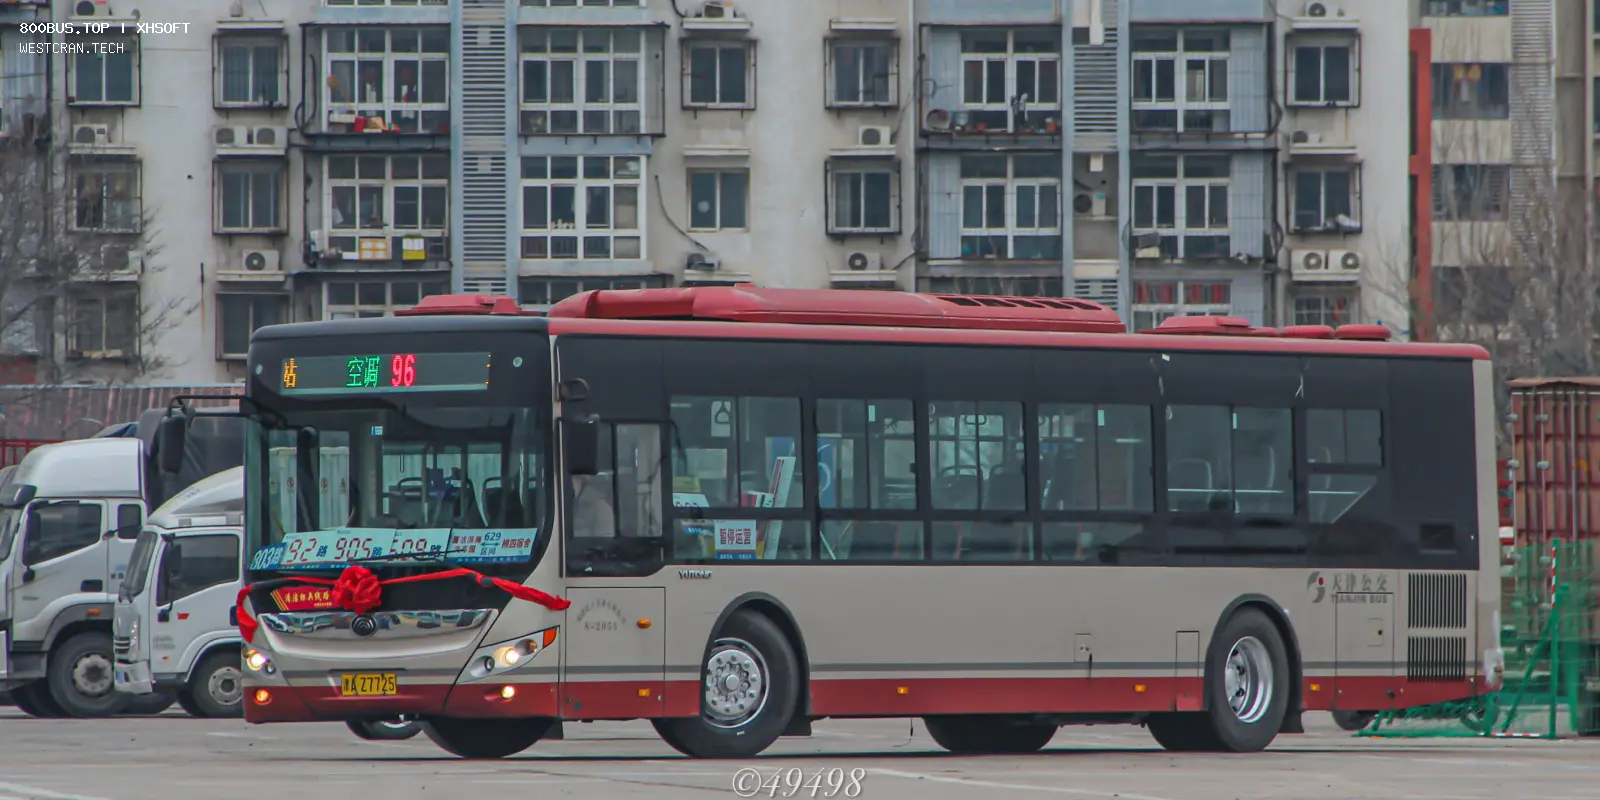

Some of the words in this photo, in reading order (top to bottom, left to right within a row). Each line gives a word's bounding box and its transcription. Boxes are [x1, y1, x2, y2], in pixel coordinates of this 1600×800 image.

[346, 356, 380, 388] 空调
[391, 353, 416, 388] 96
[484, 532, 502, 541] 629
[719, 528, 752, 546] 暂停运营
[480, 548, 497, 556] 区间
[679, 570, 712, 580] YUTONG
[1332, 572, 1388, 592] 天津公交
[1369, 594, 1388, 604] BUS
